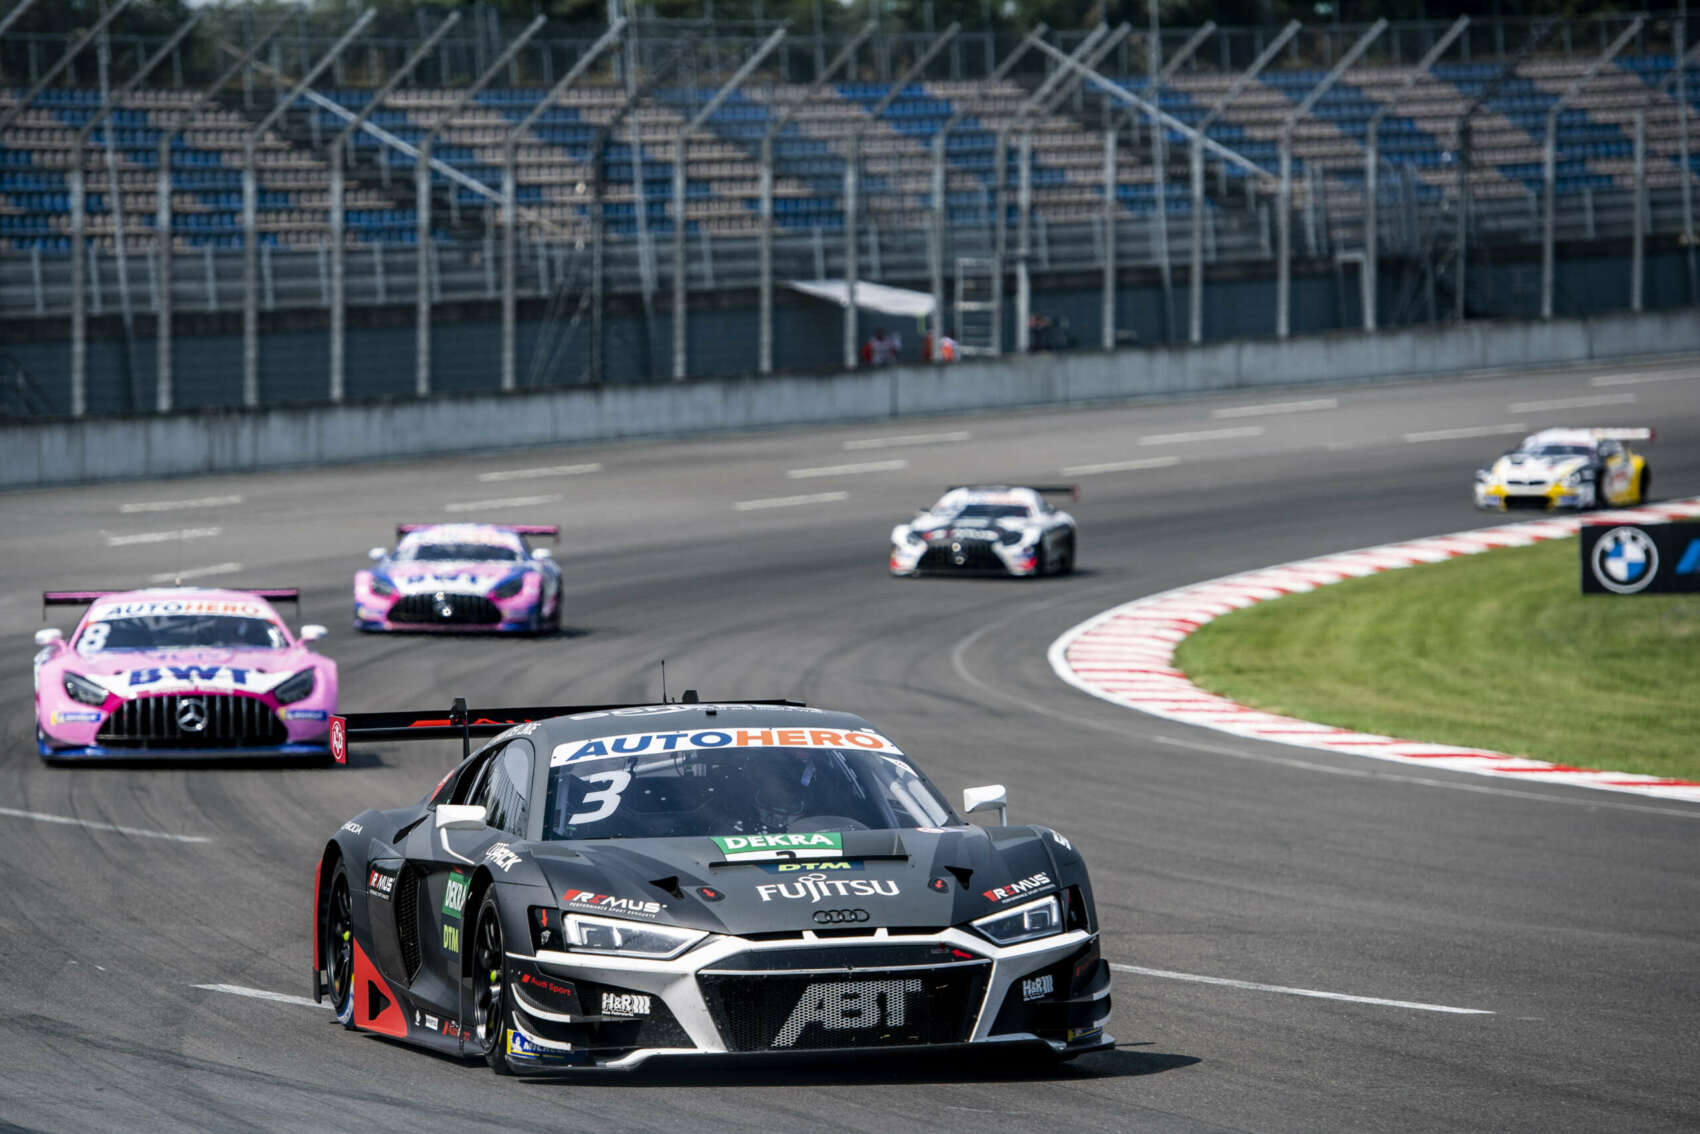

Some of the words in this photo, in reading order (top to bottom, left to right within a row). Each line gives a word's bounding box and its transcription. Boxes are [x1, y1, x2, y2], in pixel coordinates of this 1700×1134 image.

[77, 622, 109, 652] 8
[129, 665, 251, 686] BWT
[565, 729, 884, 762] AUTOHERO
[568, 770, 632, 825] 3
[723, 833, 834, 850] DEKRA
[778, 861, 852, 872] DTM
[755, 873, 901, 903] FUJITSU
[992, 873, 1052, 900] REMUS
[572, 890, 661, 914] REMUS
[443, 924, 459, 953] DTM
[771, 978, 923, 1048] ABT
